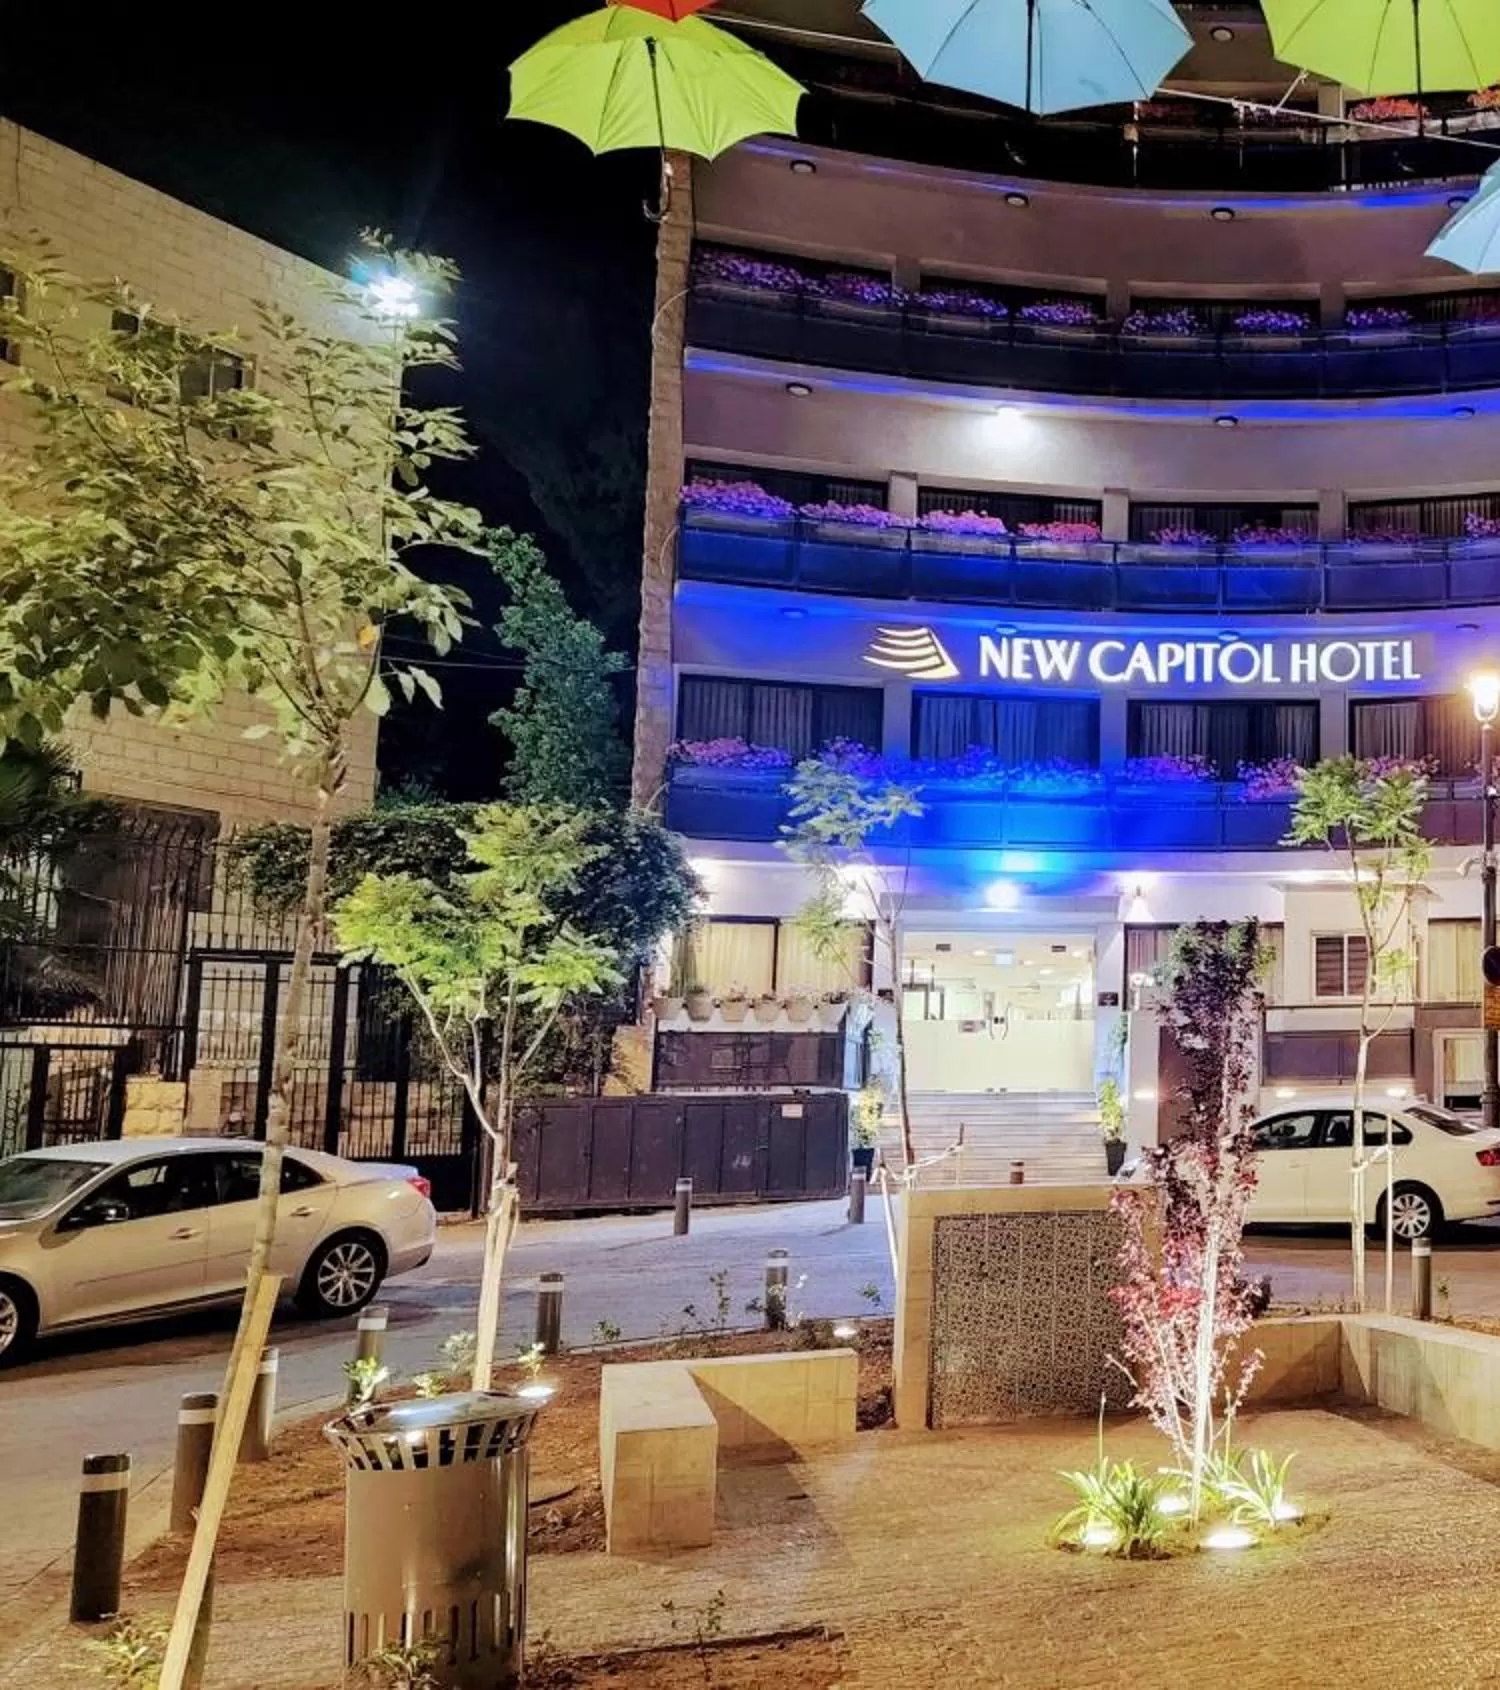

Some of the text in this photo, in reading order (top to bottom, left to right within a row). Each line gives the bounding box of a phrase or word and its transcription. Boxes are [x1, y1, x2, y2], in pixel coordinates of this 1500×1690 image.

[978, 635, 1422, 683] NEW CAPITOL HOTEL
